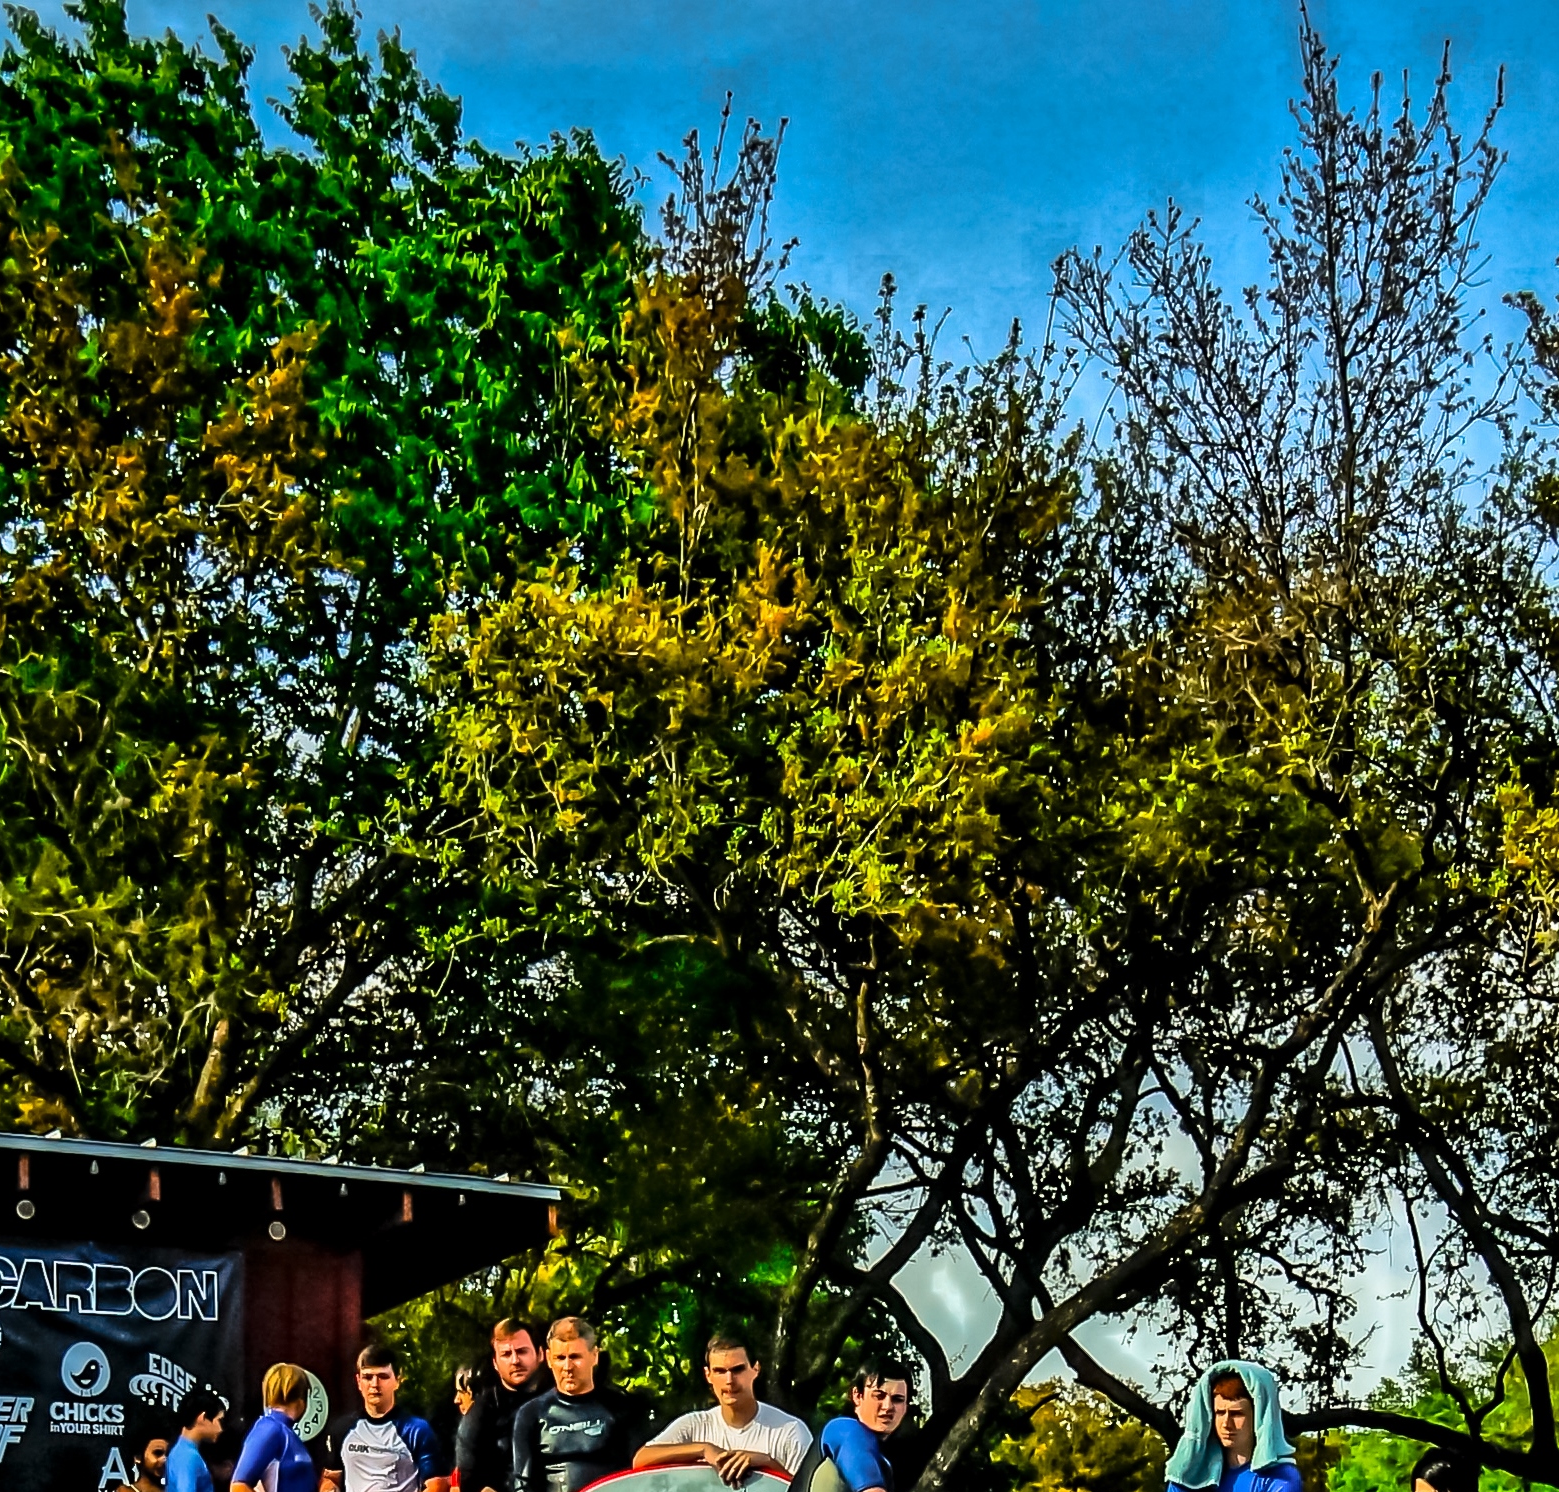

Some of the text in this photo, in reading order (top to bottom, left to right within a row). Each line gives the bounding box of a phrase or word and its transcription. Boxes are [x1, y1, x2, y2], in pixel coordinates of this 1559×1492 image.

[312, 1386, 320, 1399] 2
[50, 1401, 125, 1424] CHICKS
[315, 1400, 323, 1413] 3
[92, 1424, 125, 1436] SHIRT
[303, 1421, 312, 1435] 5
